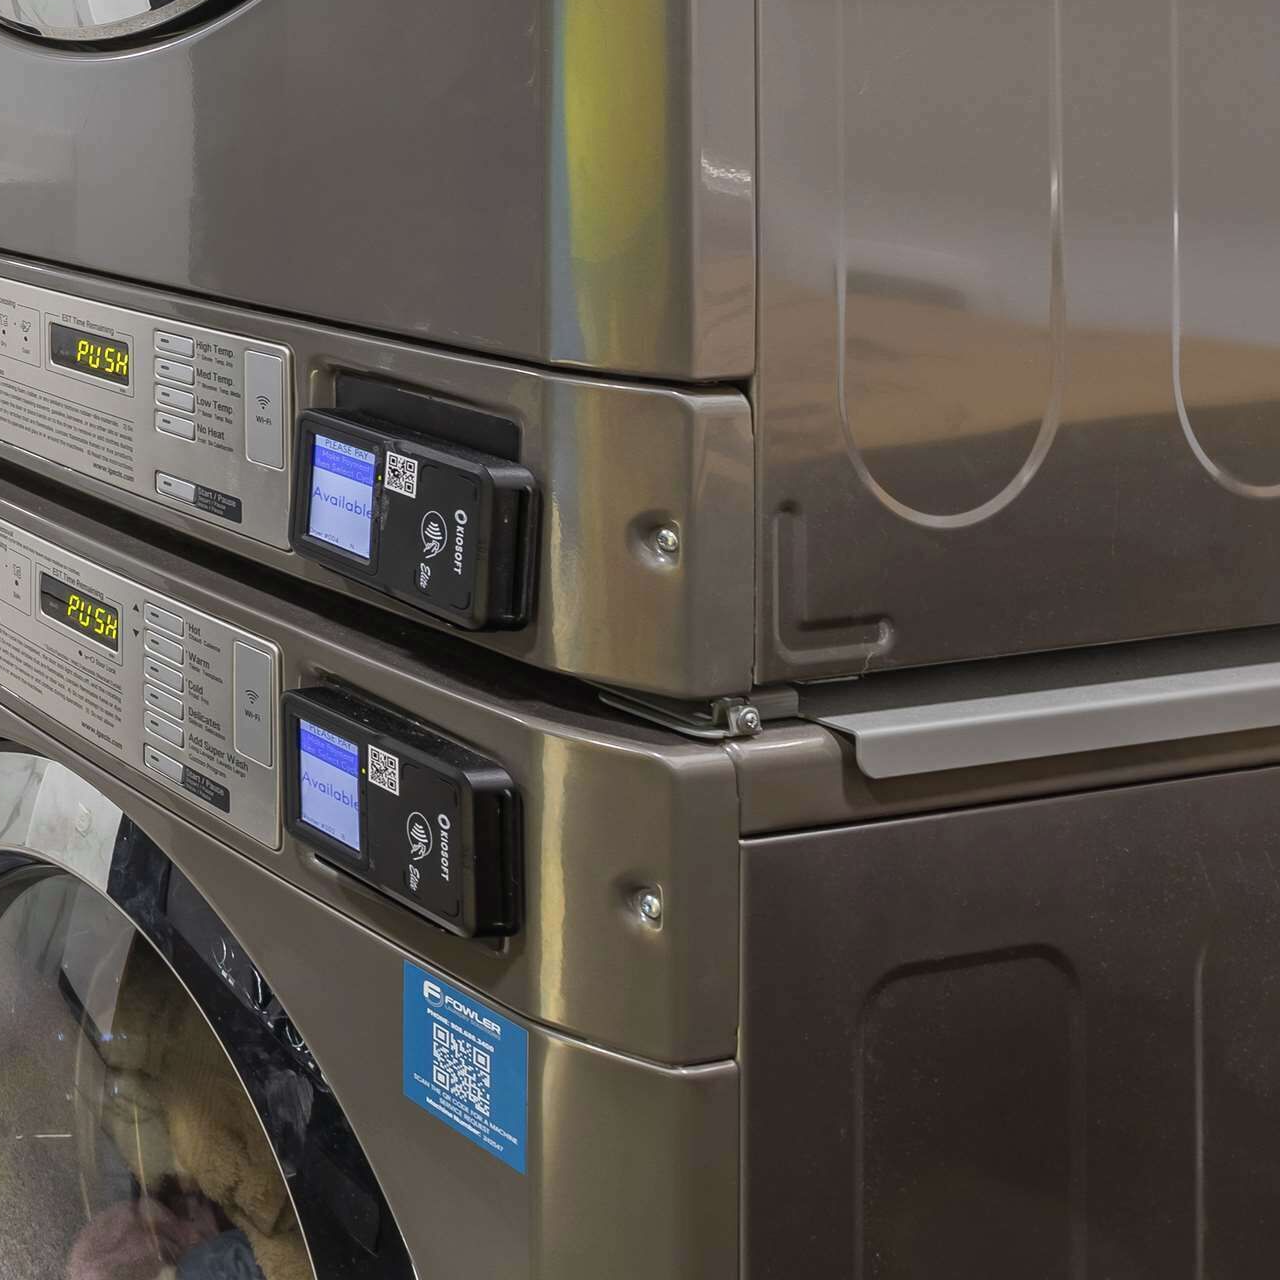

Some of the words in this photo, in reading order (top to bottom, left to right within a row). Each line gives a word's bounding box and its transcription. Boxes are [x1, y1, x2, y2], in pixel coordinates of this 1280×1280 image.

[62, 313, 73, 323] EST
[73, 316, 86, 327] Time
[86, 320, 115, 336] Remaining
[76, 339, 129, 376] PUSH
[196, 340, 212, 353] High
[196, 368, 212, 380] Med
[196, 396, 212, 408] Low
[197, 423, 207, 435] No
[207, 426, 225, 441] Heat
[255, 415, 272, 425] Wi-Fi
[324, 439, 352, 456] PLEASE
[354, 450, 369, 460] PAY
[313, 485, 374, 520] Available
[453, 526, 465, 576] KIOSOFT
[52, 567, 63, 579] EST
[63, 573, 76, 585] Time
[76, 580, 104, 601] Remaining
[420, 562, 431, 589] Elite
[67, 594, 118, 640] PUSH
[188, 651, 210, 670] Warm
[188, 680, 204, 696] Cold
[188, 706, 221, 732] Delicates
[244, 708, 261, 721] Wi-Fi
[188, 733, 203, 746] Add
[203, 738, 225, 759] Super
[226, 751, 249, 773] Wash
[302, 771, 360, 811] Available
[440, 831, 450, 882] KIOSOFT
[408, 863, 421, 893] Elite
[445, 995, 501, 1036] FOWLER
[413, 1072, 430, 1088] SCAN
[441, 1091, 452, 1102] QR
[452, 1098, 469, 1113] CODE
[470, 1109, 483, 1122] FOR
[489, 1122, 518, 1146] MACHINE
[426, 1096, 453, 1119] Machine
[439, 1097, 462, 1117] SERVICE
[463, 1112, 490, 1135] REQUEST
